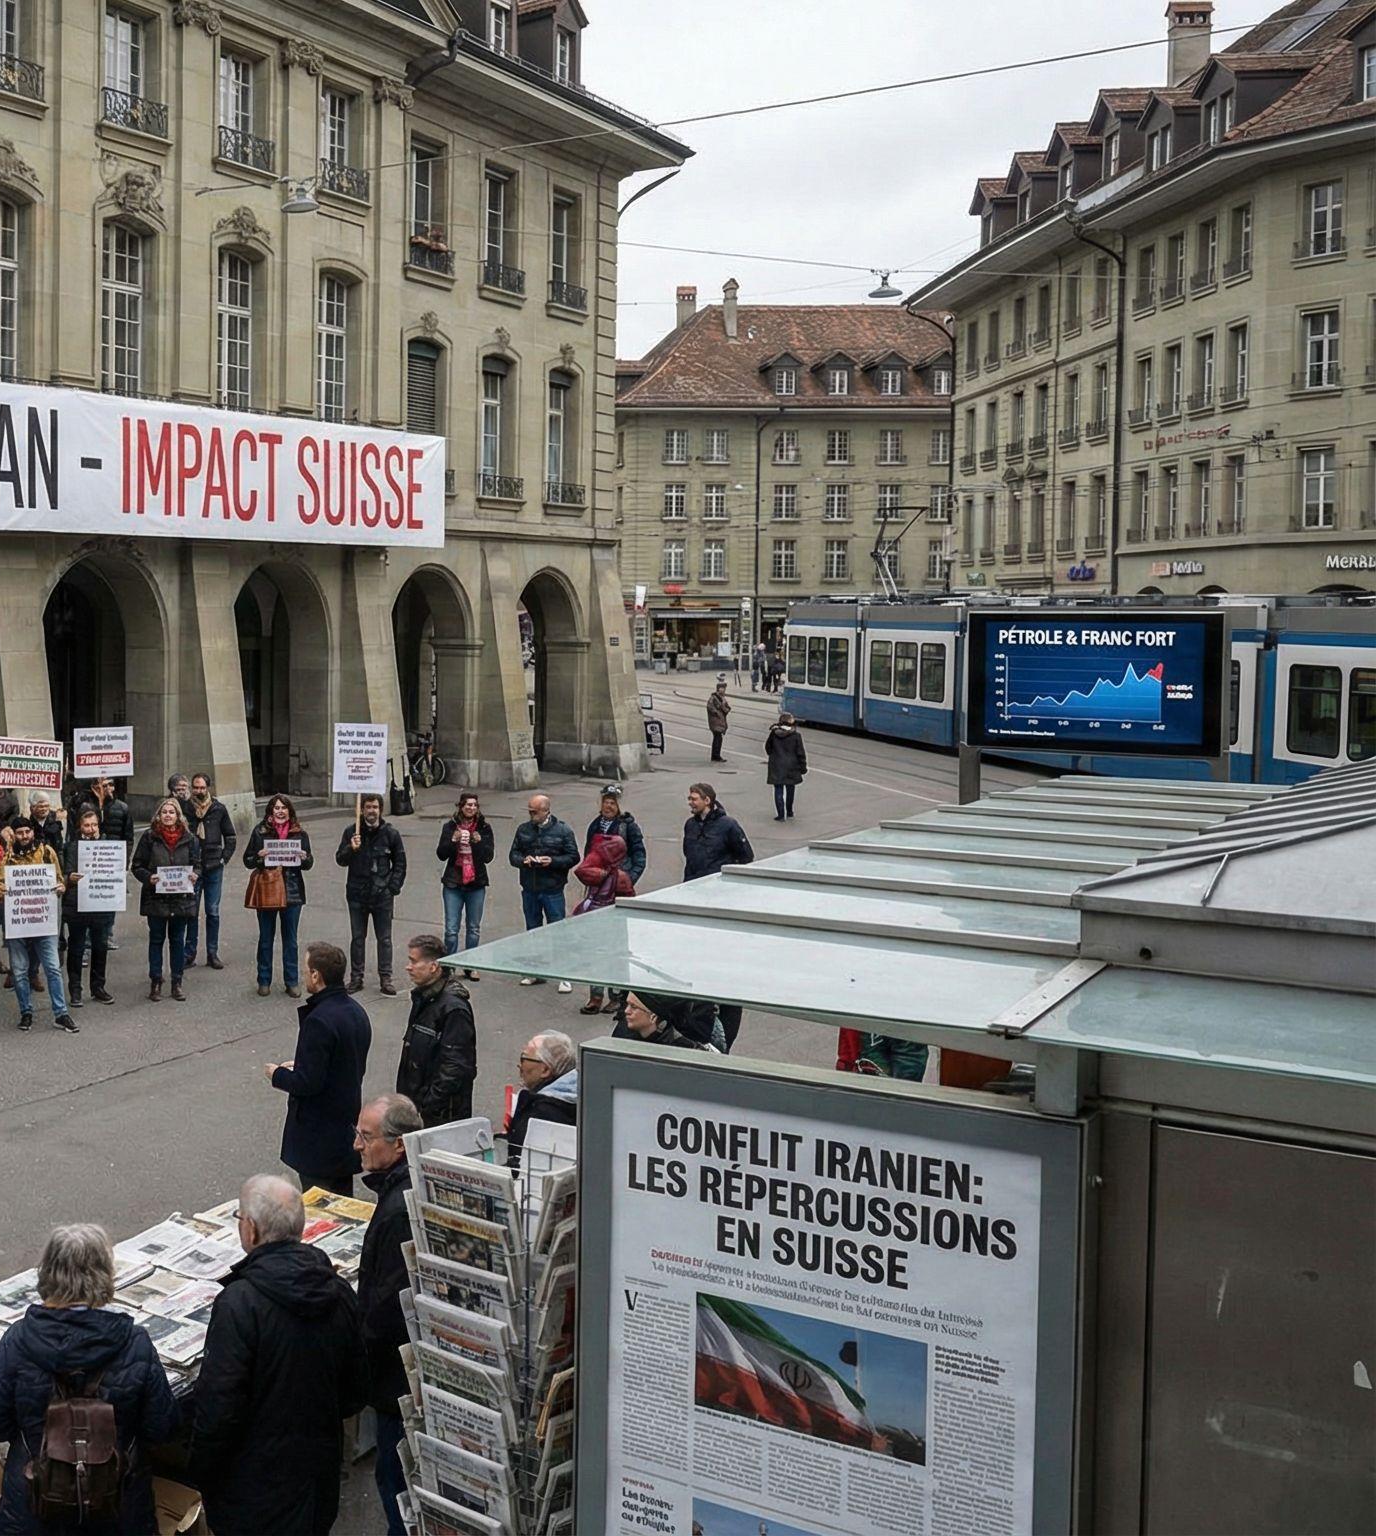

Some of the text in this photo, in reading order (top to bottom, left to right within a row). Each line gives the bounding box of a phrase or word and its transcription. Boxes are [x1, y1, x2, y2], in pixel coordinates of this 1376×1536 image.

[122, 416, 283, 523] IMPACT
[298, 436, 424, 531] SUISSE
[998, 625, 1176, 647] PÉTROLE & FRANC FORT
[656, 1112, 984, 1205] CONFLIT IRANIEN:
[627, 1152, 1018, 1261] LES RÉPERCUSSIONS
[716, 1215, 909, 1290] EN SUISSE
